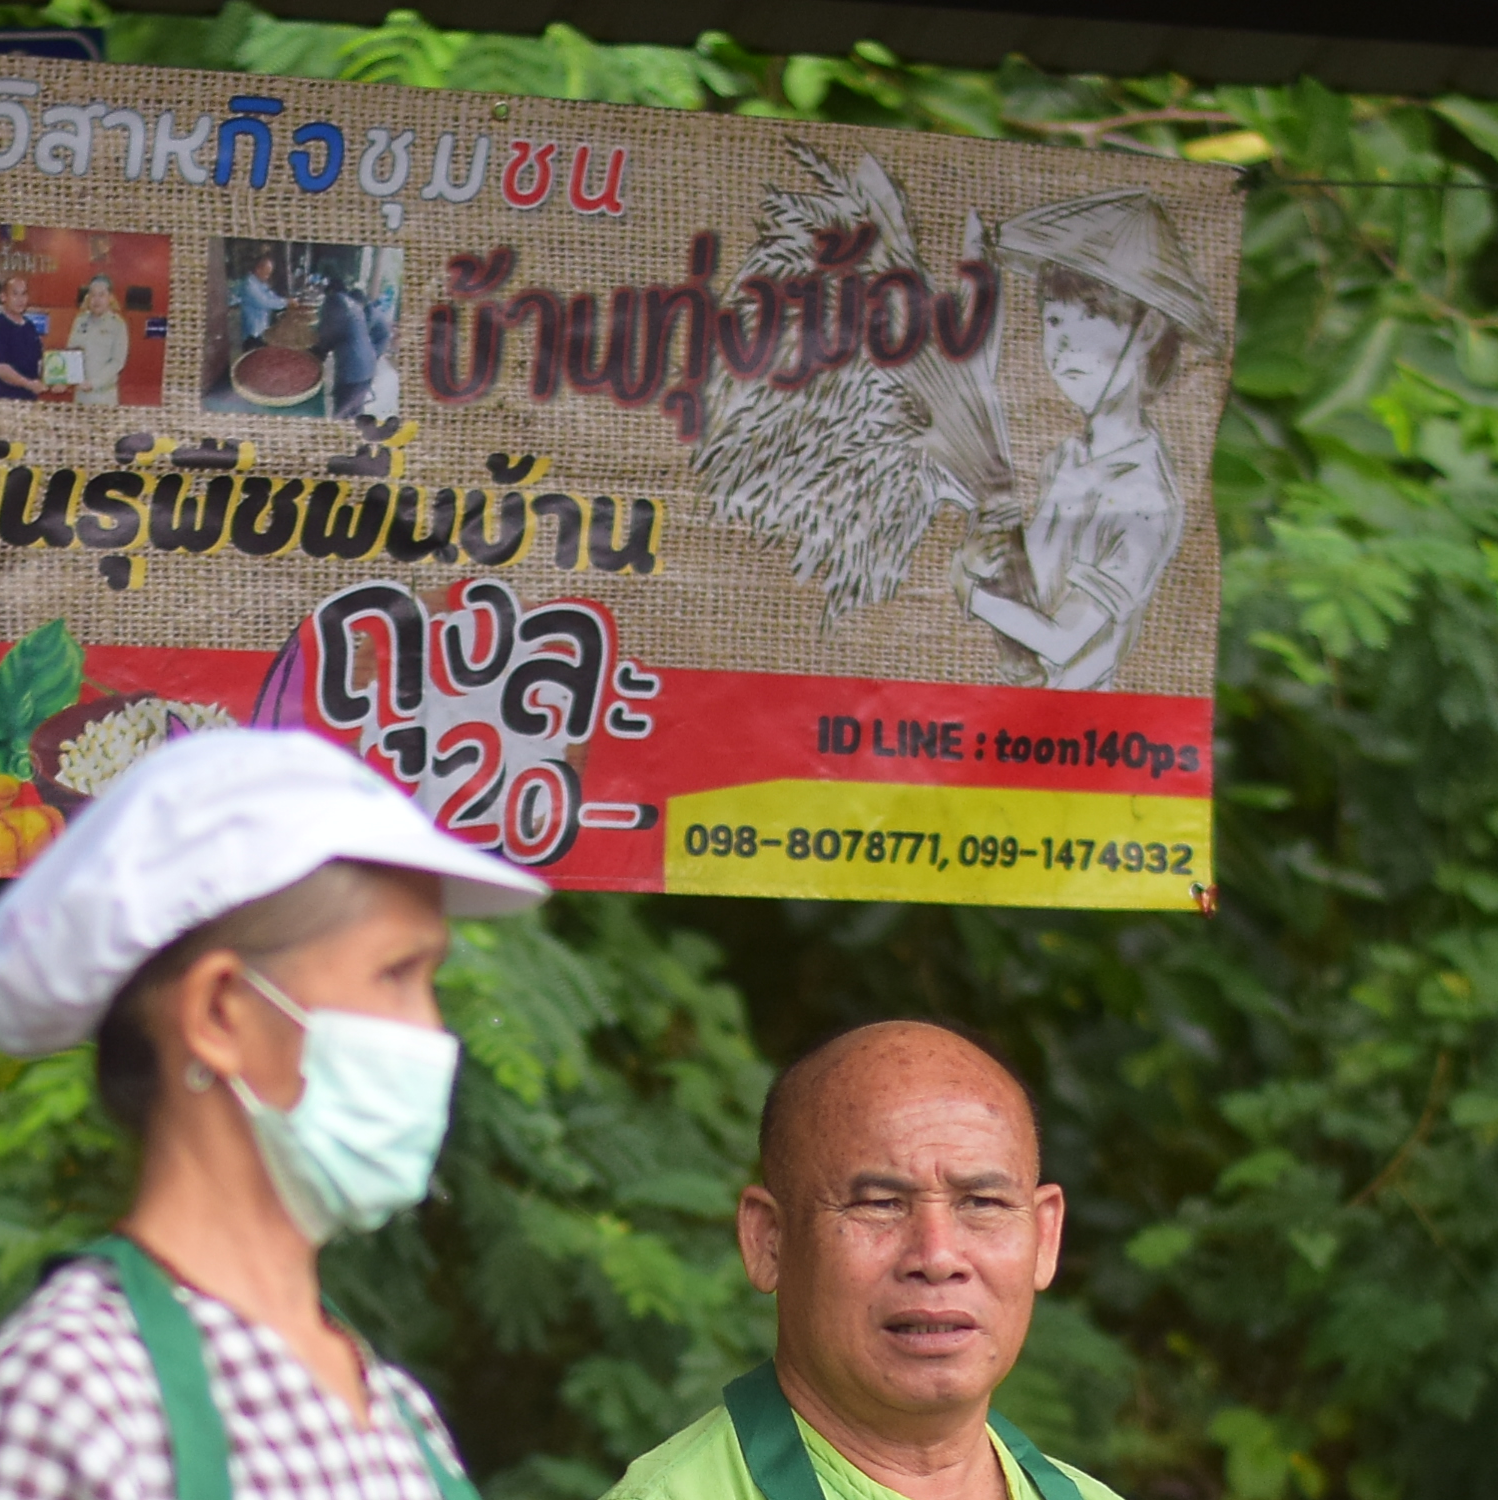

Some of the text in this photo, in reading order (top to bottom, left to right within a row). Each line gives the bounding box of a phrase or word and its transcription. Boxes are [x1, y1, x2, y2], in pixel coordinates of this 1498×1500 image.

[817, 715, 861, 756] ID
[873, 718, 964, 763] LINE
[994, 728, 1201, 780] toon140ps
[958, 835, 1194, 876] 099-1474932
